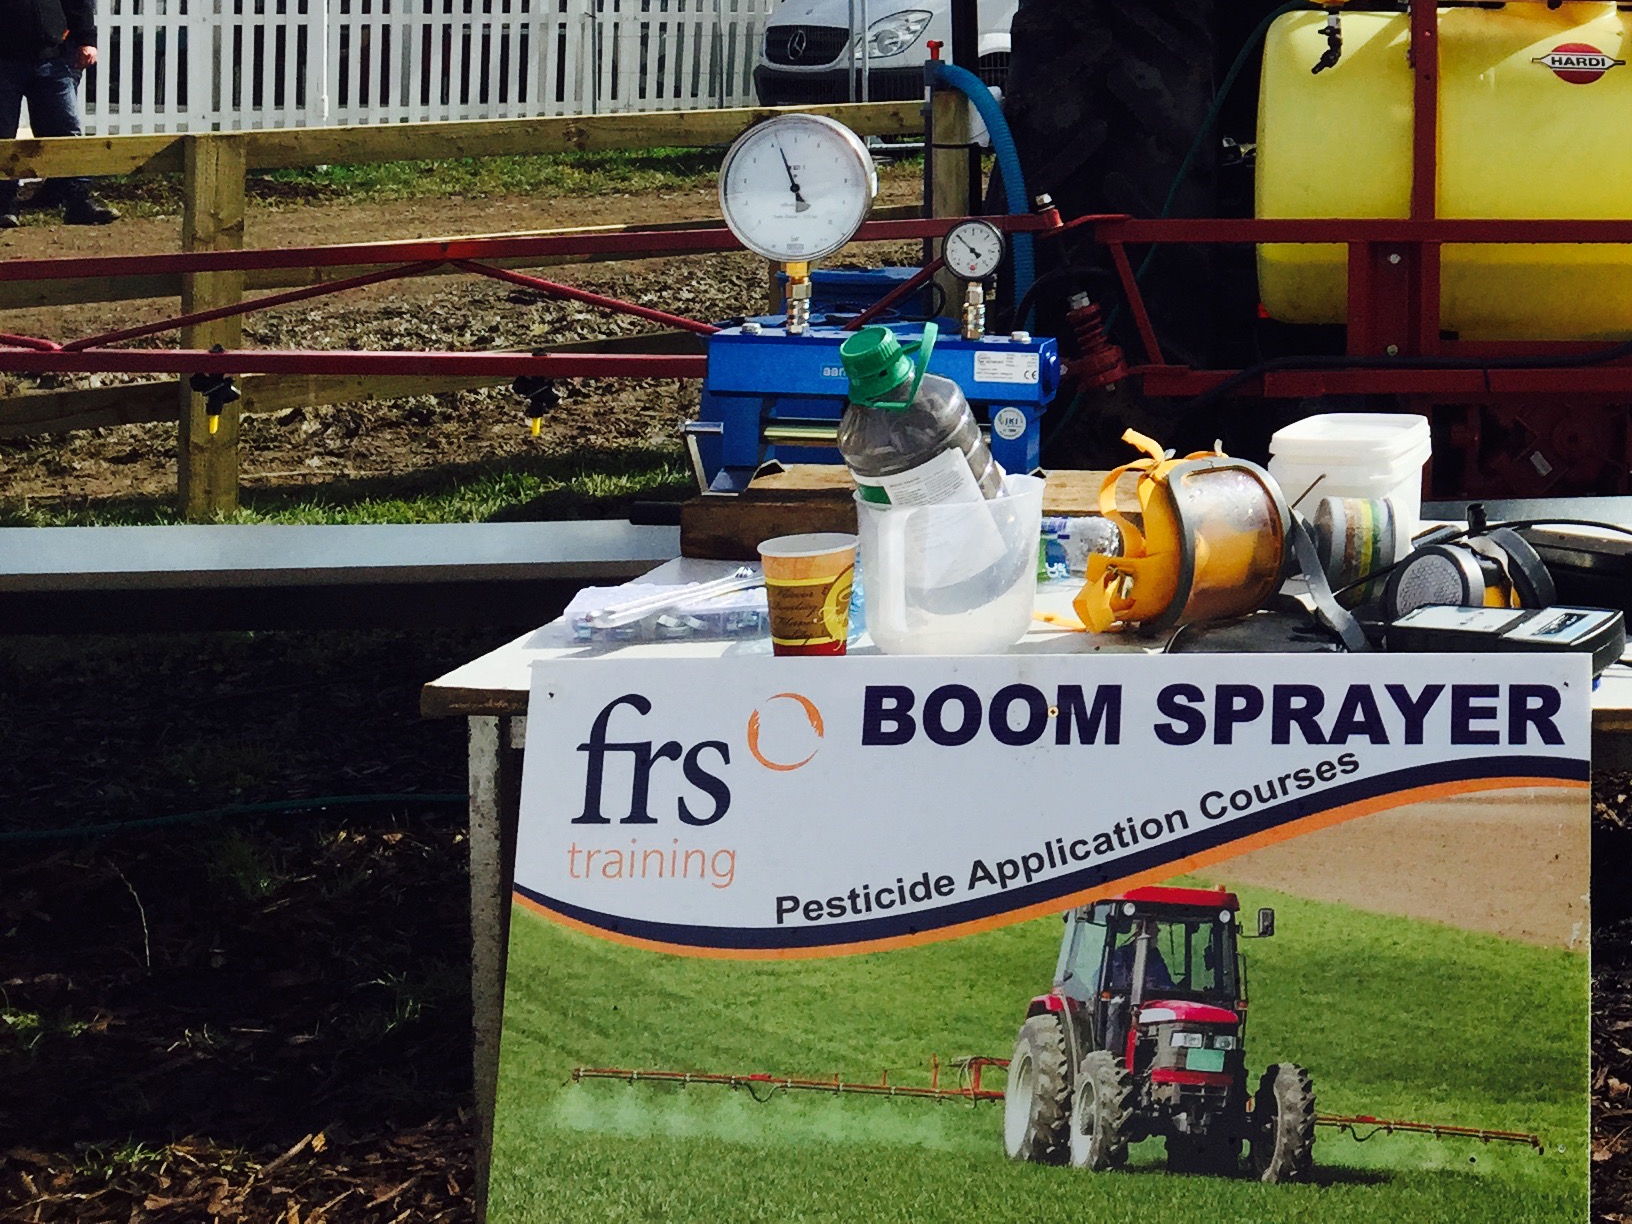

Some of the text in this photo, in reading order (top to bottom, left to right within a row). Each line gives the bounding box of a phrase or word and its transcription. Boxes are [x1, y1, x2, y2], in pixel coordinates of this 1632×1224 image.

[1551, 57, 1606, 68] HARDI
[862, 683, 1566, 746] BOOM SPRAYER
[571, 694, 731, 827] frs
[567, 838, 736, 889] training
[775, 751, 1361, 924] Pesticide Application Courses
